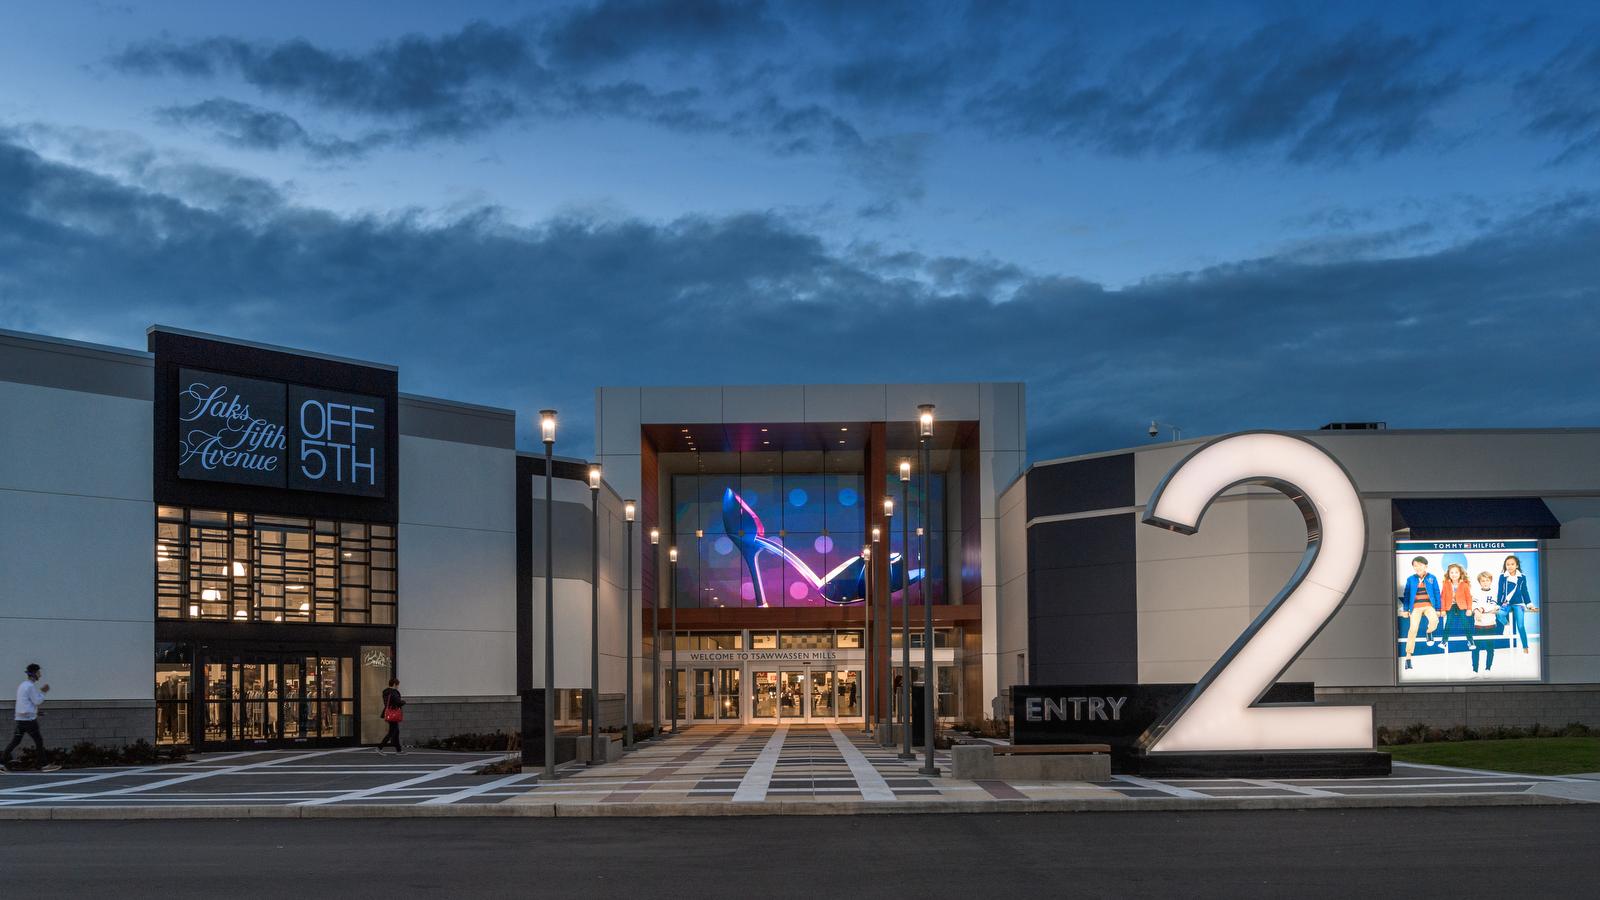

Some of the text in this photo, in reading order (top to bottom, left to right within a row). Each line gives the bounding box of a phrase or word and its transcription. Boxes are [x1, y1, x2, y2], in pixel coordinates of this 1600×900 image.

[180, 382, 250, 421] Saks
[300, 399, 375, 444] OFF
[180, 429, 278, 471] Avenue
[301, 440, 375, 485] 5TH
[1026, 430, 1376, 754] ENTRY 2
[690, 653, 734, 661] WELCOME
[751, 652, 810, 660] TSAWWASSEN
[812, 651, 837, 659] MILLS
